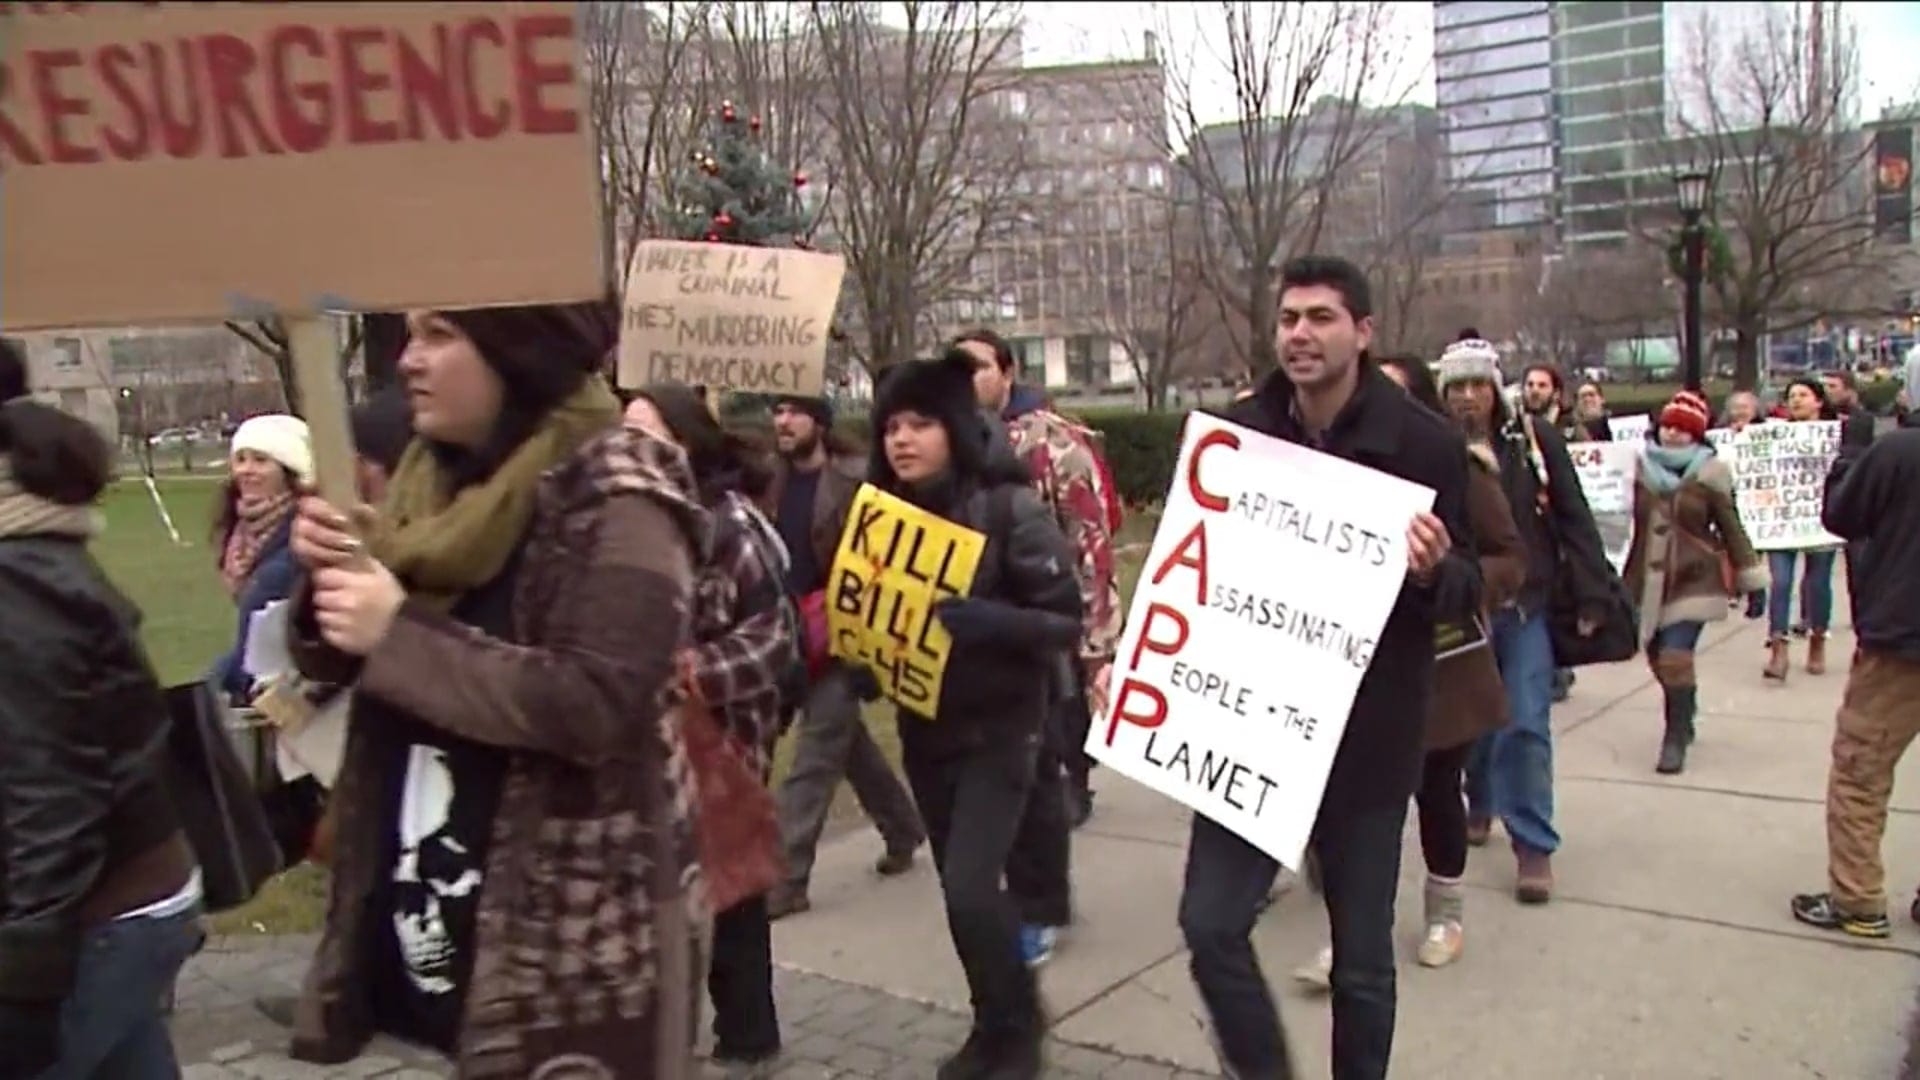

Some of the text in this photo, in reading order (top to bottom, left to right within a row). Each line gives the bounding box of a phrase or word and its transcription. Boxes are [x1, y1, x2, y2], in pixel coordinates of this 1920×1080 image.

[762, 252, 779, 273] A
[648, 351, 807, 390] DEMOCRACY
[678, 313, 817, 347] MURDERING
[1186, 429, 1391, 567] CAPITALISTS
[851, 502, 960, 595] KILL
[1152, 519, 1378, 669] ASSASSINATING
[836, 568, 940, 660] BILL
[1129, 601, 1252, 717] PEOPLE
[1283, 704, 1319, 741] THE
[1105, 677, 1279, 819] PLANET
